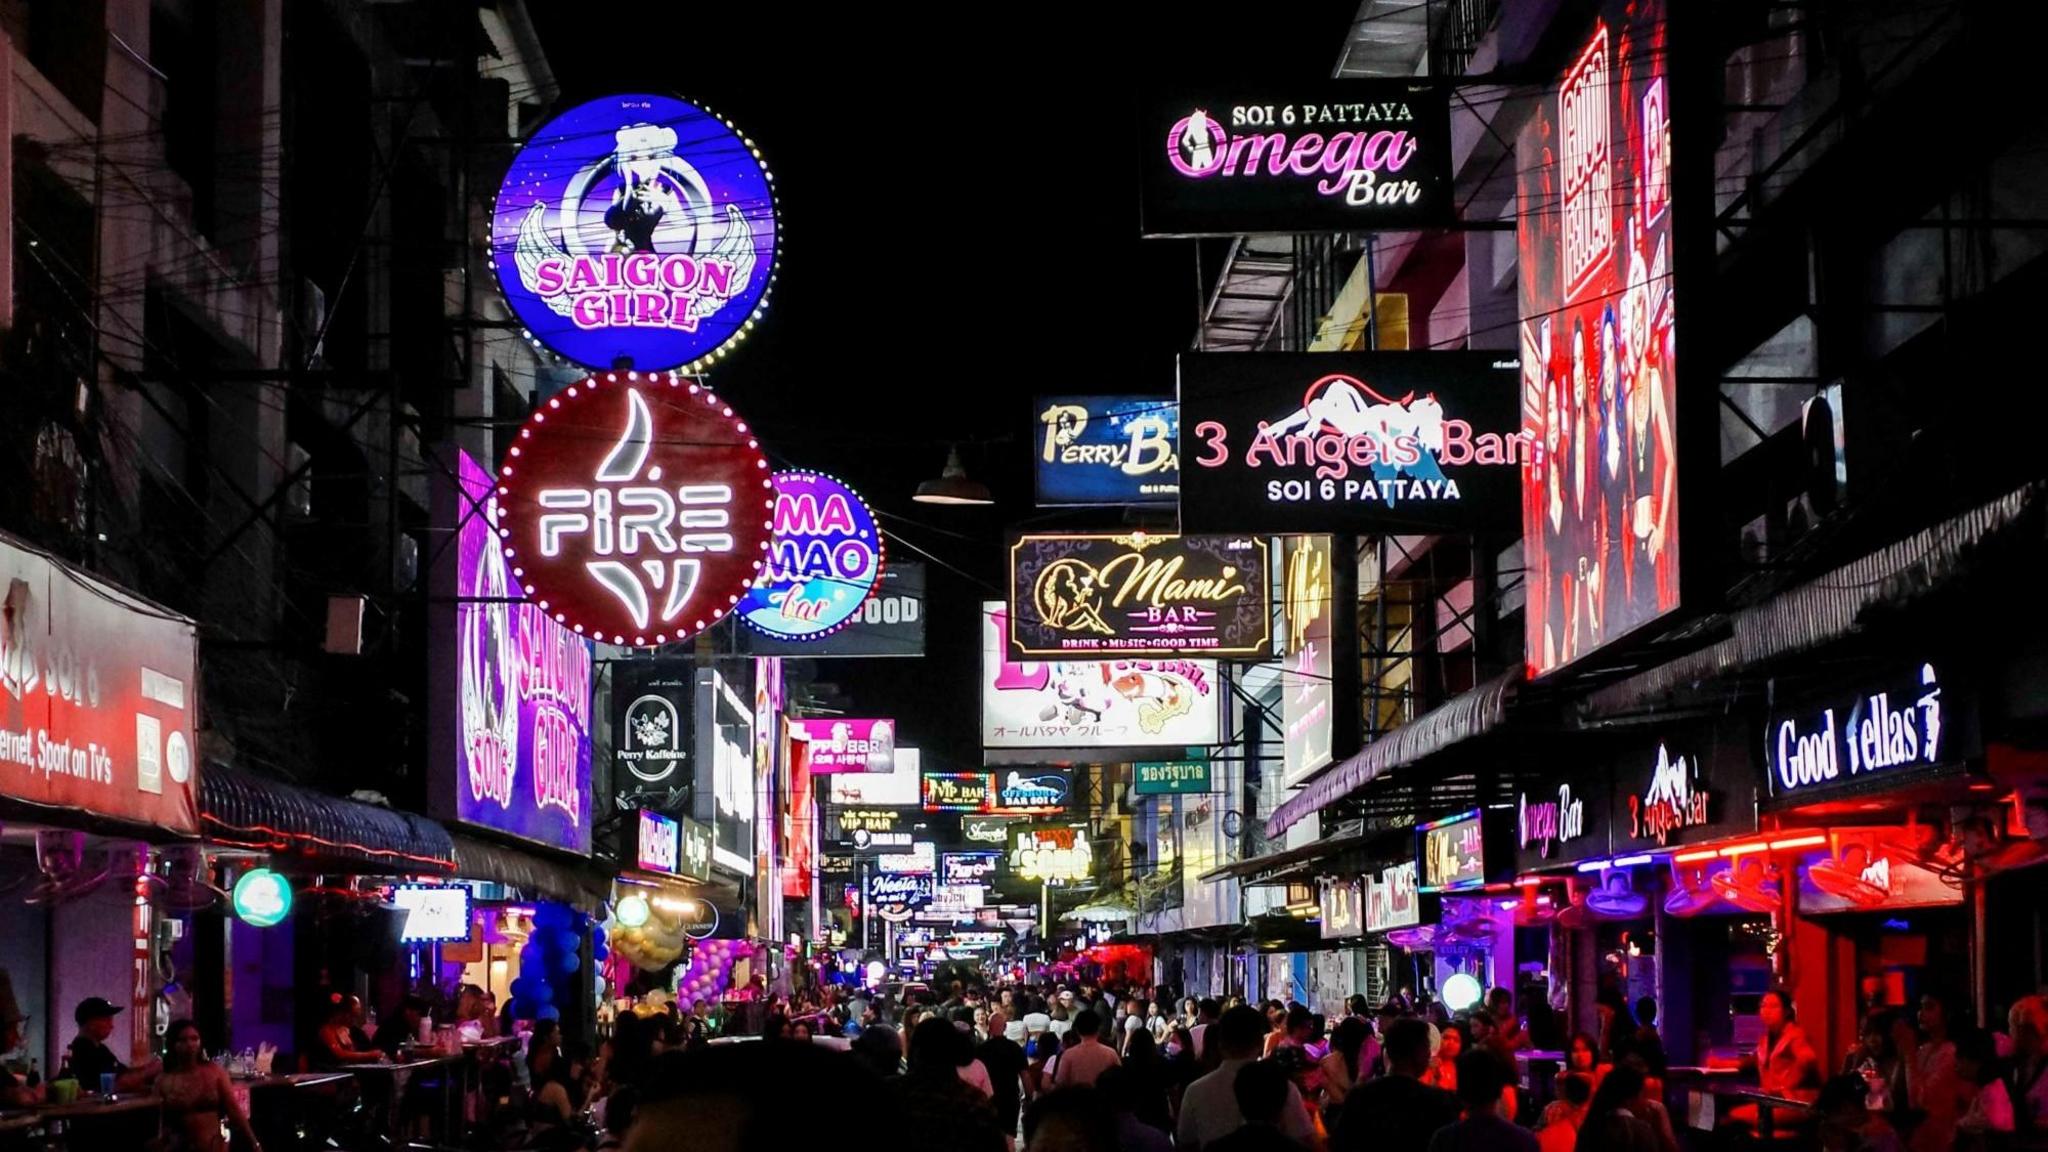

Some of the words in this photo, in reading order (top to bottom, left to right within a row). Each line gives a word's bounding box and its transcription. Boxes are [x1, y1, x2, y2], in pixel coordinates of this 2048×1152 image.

[1232, 105, 1275, 126] SOI
[1282, 104, 1296, 126] 6
[1303, 102, 1413, 124] PATTAYA
[1167, 113, 1417, 195] Omega
[1346, 169, 1421, 206] Bar
[535, 253, 735, 297] SAIGON
[571, 290, 700, 333] GIRL
[1195, 421, 1229, 467] 3
[1438, 419, 1530, 466] Bar
[1267, 480, 1311, 501] SOI
[1320, 479, 1336, 501] 6
[1344, 479, 1461, 501] PATTAYA
[538, 485, 734, 557] FIRE
[773, 493, 857, 536] MA
[757, 539, 874, 583] MAO
[1099, 552, 1246, 608] Mami
[768, 583, 829, 621] bar
[1148, 606, 1198, 622] BAR
[1062, 638, 1099, 649] DRINK
[1109, 638, 1146, 649] MUSIC
[1152, 638, 1186, 649] GOOD
[1188, 638, 1220, 648] TIME
[519, 603, 591, 737] SAIGON
[37, 729, 70, 780] Sport
[71, 748, 87, 779] on
[89, 741, 112, 785] Tv's
[533, 706, 580, 827] GIRL
[617, 749, 645, 763] Perry
[646, 749, 687, 761] Kaffeine
[1778, 708, 1839, 789] Good
[937, 786, 958, 798] VIP
[962, 786, 985, 798] BAR
[1005, 797, 1028, 805] BAR
[1559, 783, 1584, 843] Bar
[839, 817, 861, 830] VIP
[866, 817, 891, 830] BAR
[1628, 794, 1639, 840] 3
